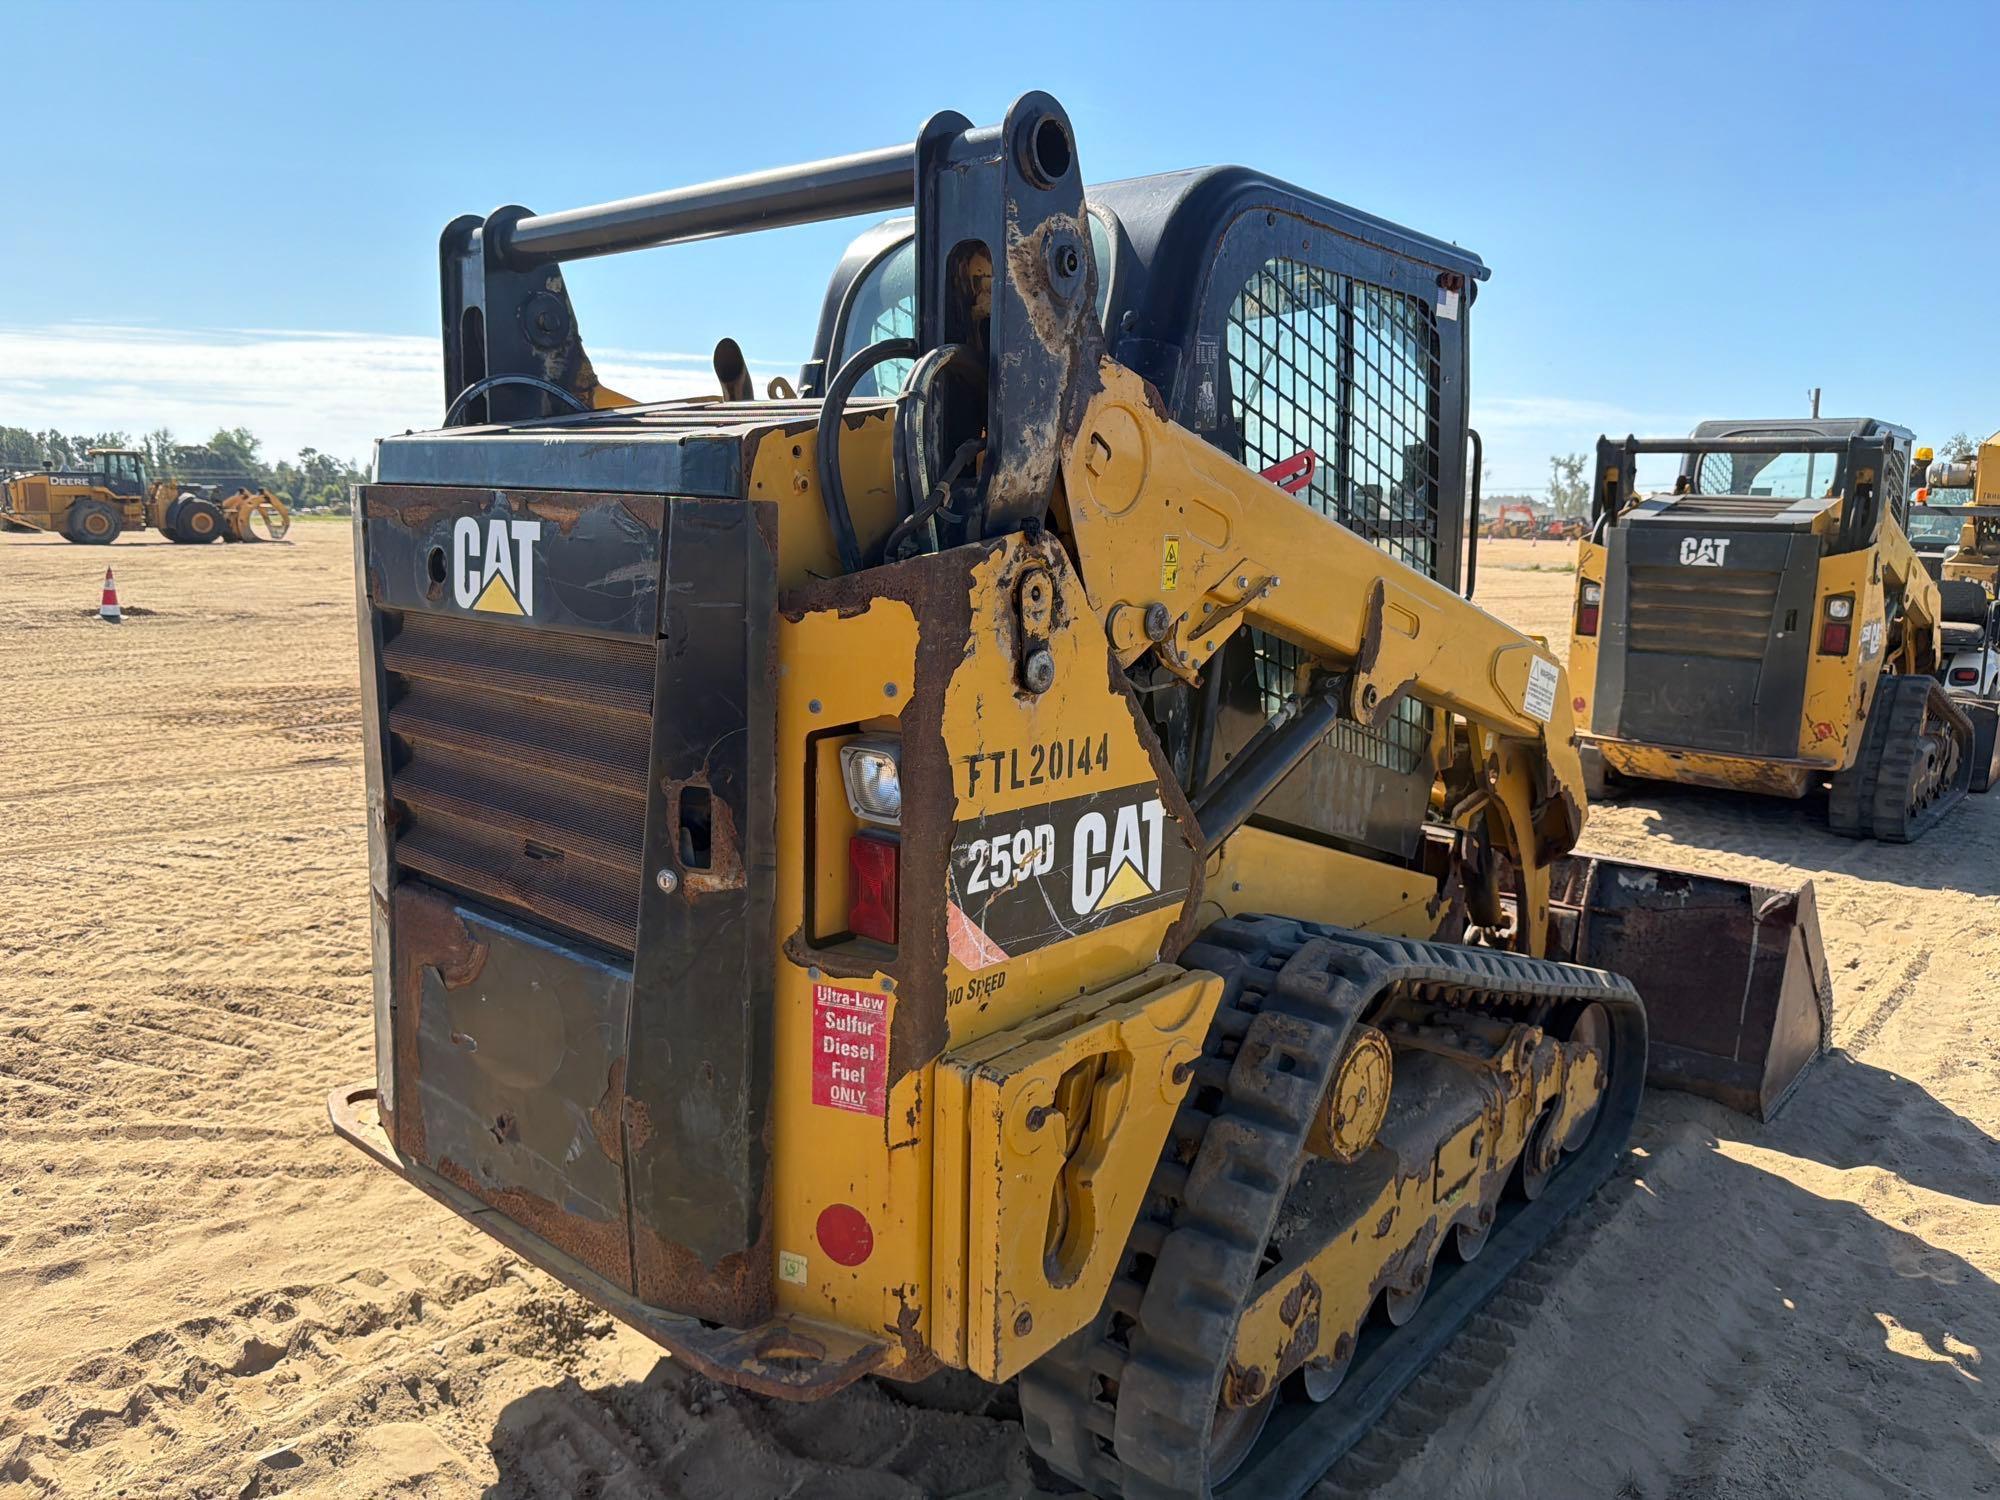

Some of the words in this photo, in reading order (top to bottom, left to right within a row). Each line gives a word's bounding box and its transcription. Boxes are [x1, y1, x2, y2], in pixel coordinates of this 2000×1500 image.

[50, 476, 89, 486] DEERE
[1680, 537, 1730, 567] CAT
[454, 516, 541, 616] CAT
[962, 733, 1109, 798] FTL20144
[967, 823, 1055, 895] 259D
[1072, 799, 1166, 915] CAT
[818, 986, 884, 1010] Ultra-Low
[967, 971, 1006, 1000] SPEED
[825, 1011, 874, 1036] Sulfur
[823, 1035, 874, 1061] Diesel
[832, 1061, 865, 1084] Fuel
[830, 1085, 866, 1105] ONLY
